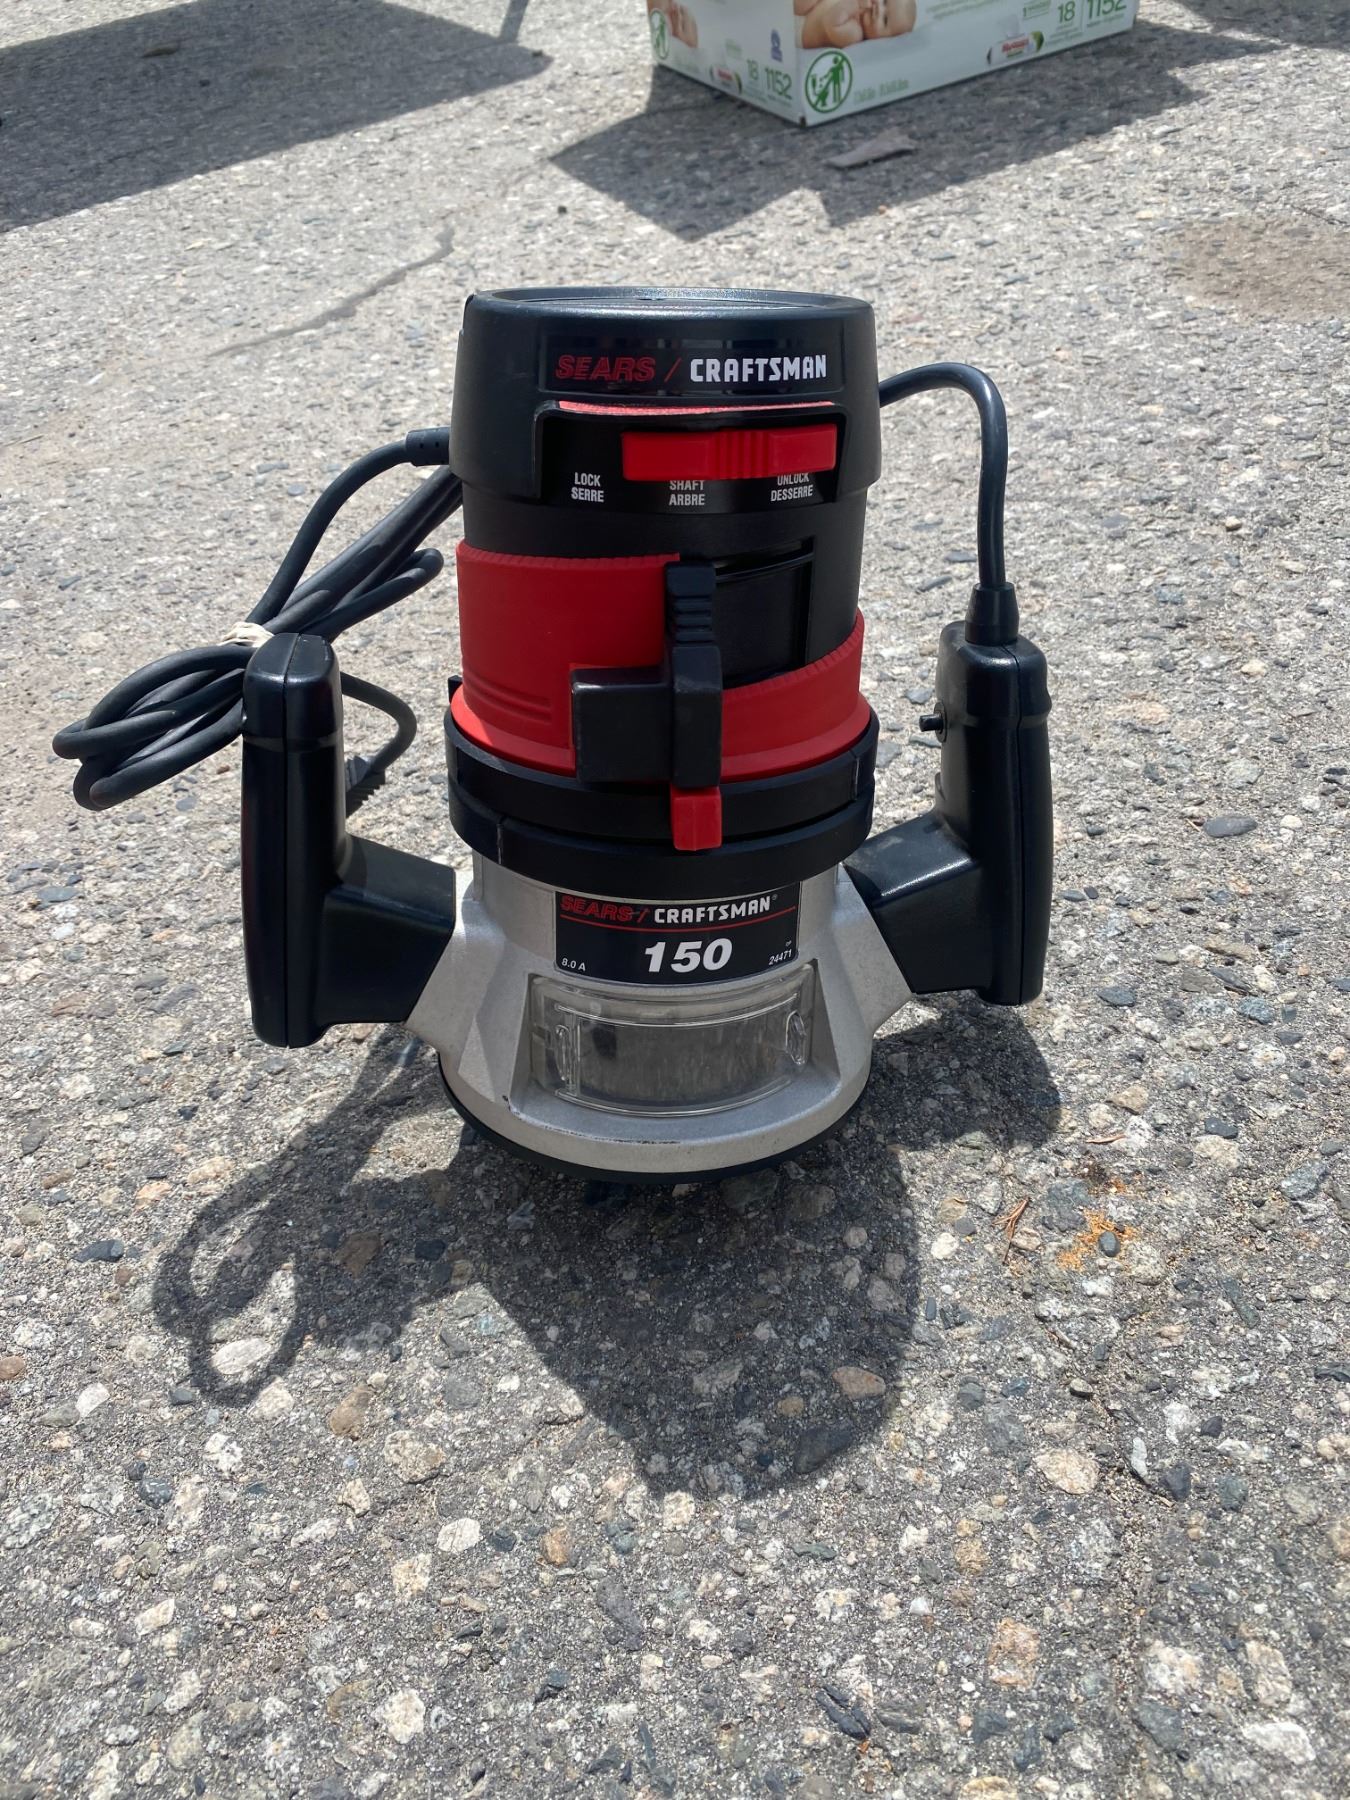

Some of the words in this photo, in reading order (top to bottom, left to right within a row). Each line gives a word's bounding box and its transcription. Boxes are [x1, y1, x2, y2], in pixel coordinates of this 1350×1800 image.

[1057, 1, 1076, 23] 18
[765, 66, 792, 100] 1152
[555, 354, 656, 382] SEARS
[690, 354, 827, 382] CRAFTSMAN
[574, 471, 601, 487] LOCK
[669, 479, 705, 491] SHAFT
[776, 472, 810, 486] UNLOCK
[571, 486, 604, 502] SERRE
[668, 492, 705, 506] ARBRE
[770, 484, 814, 502] DESSERRE
[560, 894, 633, 923] SEARS
[654, 895, 771, 924] CRAFTSMAN
[644, 937, 733, 973] 150
[768, 948, 792, 967] 24471
[561, 957, 577, 970] 8.0
[578, 961, 587, 972] A
